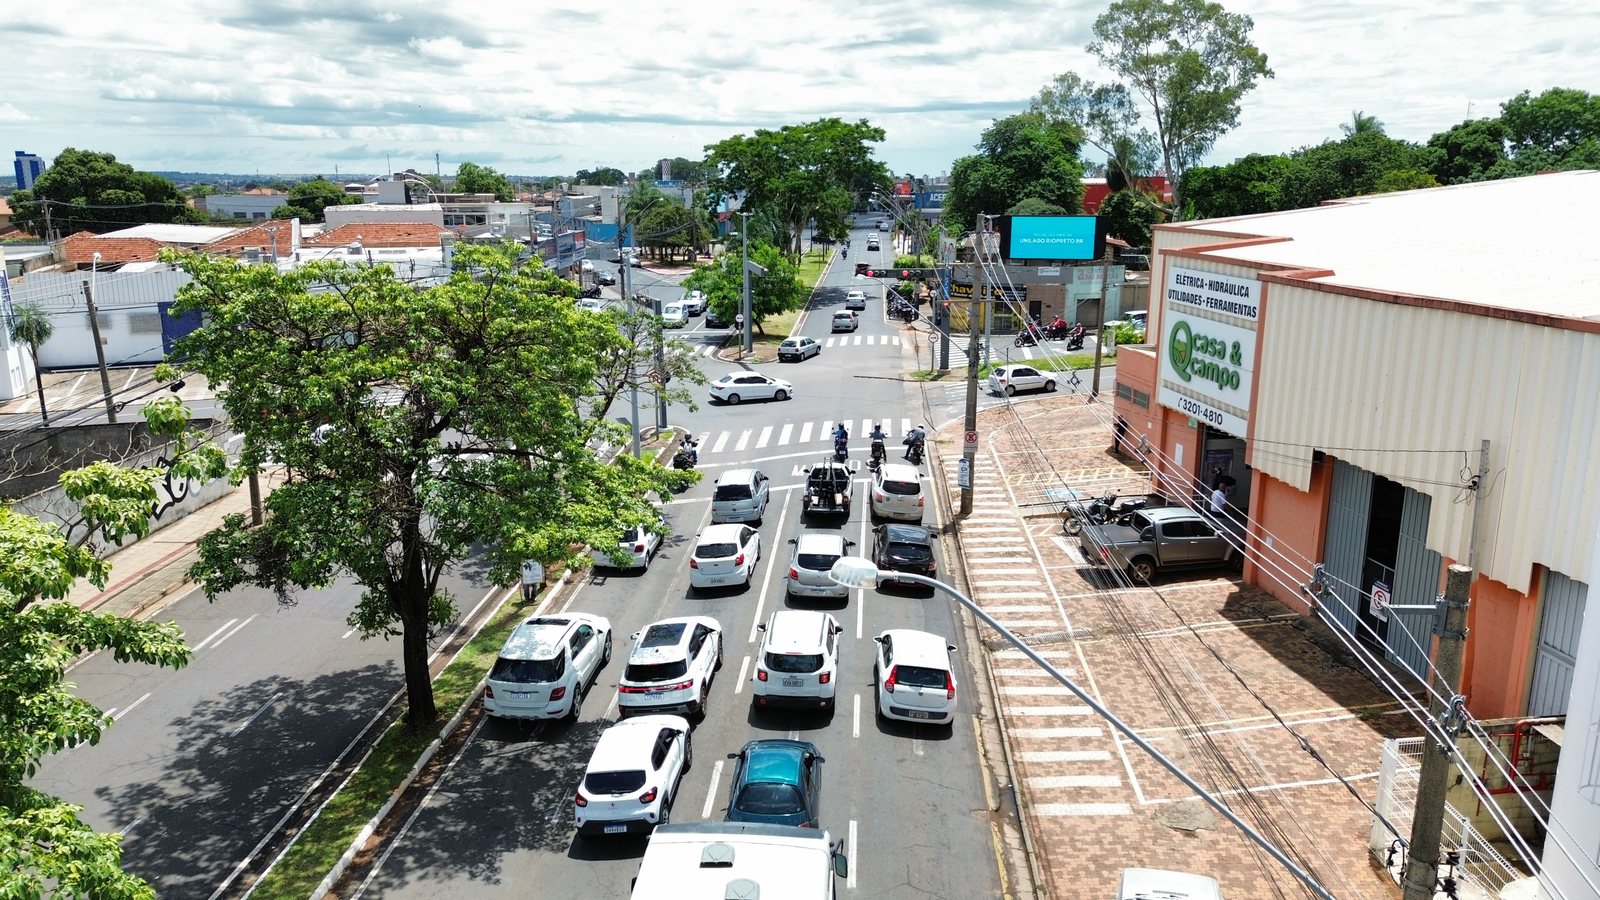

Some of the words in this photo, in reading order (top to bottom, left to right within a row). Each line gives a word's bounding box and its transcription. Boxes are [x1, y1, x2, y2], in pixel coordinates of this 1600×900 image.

[1175, 272, 1205, 290] ELÉTRICA
[1208, 279, 1250, 298] HIDRÁULICA
[1168, 288, 1208, 306] UTILIDADES
[1206, 297, 1257, 318] FERRAMENTAS
[1191, 333, 1227, 361] casa
[1229, 341, 1242, 367] &
[1189, 357, 1241, 390] campo
